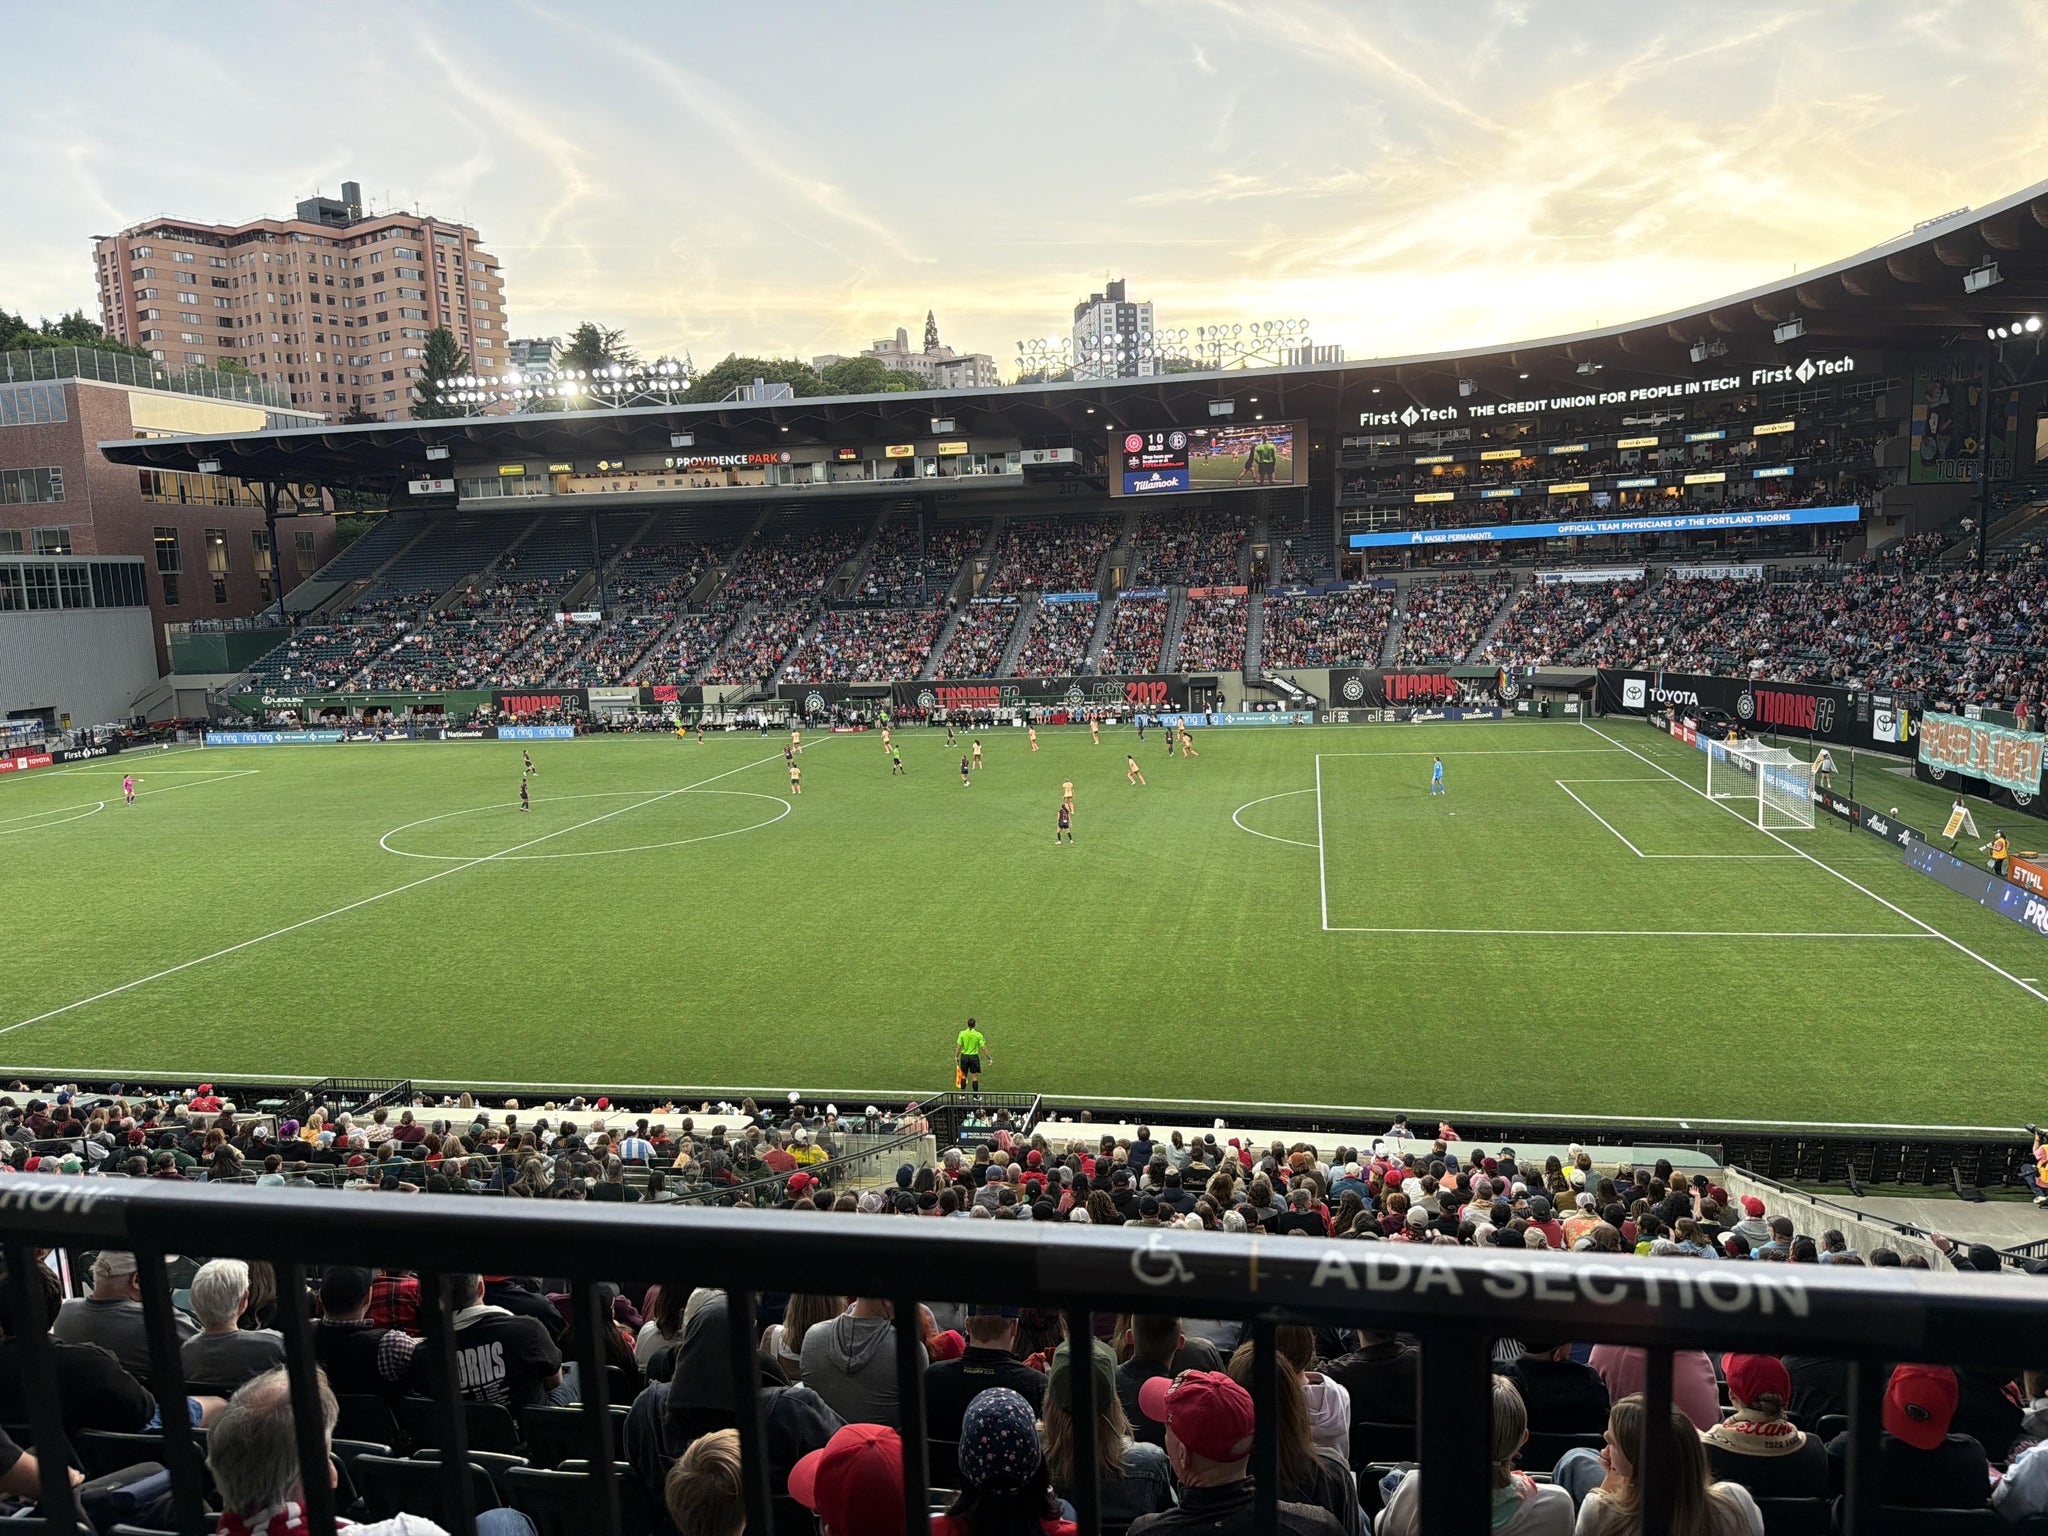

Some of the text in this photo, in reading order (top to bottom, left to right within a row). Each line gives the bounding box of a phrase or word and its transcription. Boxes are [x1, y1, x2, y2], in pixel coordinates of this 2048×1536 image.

[1752, 356, 1854, 385] First Tech
[1469, 376, 1740, 417] THE CREDIT UNION FOR PEOPLE IN TECH
[1360, 406, 1458, 426] First Tech
[1148, 433, 1163, 444] 1 0
[1690, 432, 1720, 441] THINKERS
[1553, 445, 1584, 453] CREATORS
[677, 453, 778, 468] PROVIDENCE PARK
[1759, 468, 1788, 477] BUILDERS
[1059, 483, 1080, 495] 217
[1134, 477, 1179, 491] Tillamook
[1619, 479, 1655, 487] DISRUPTORS
[1487, 489, 1514, 497] LEADERS
[1558, 513, 1791, 533] OFFICIAL TEAM PHYSICIANS OF THE PORTLAND THORNS
[1424, 535, 1447, 543] KAISER
[1127, 681, 1167, 705] 2012
[1383, 674, 1457, 700] THORNS
[935, 686, 1000, 709] THORNS
[1649, 688, 1699, 705] TOYOTA
[501, 695, 560, 717] THORNS
[1755, 690, 1835, 733] THORNS FC
[1160, 715, 1177, 725] ring
[1321, 711, 1336, 723] elf
[1367, 710, 1383, 722] elf
[1417, 711, 1446, 720] illamook
[1461, 711, 1494, 720] Tillamook
[500, 728, 515, 738] ring
[518, 728, 533, 738] ring
[539, 727, 555, 737] ring
[557, 727, 573, 737] ring
[207, 734, 221, 743] ring
[223, 734, 237, 743] ring
[243, 734, 257, 743] ring
[259, 734, 273, 743] ring
[64, 747, 107, 759] First Tech
[28, 757, 51, 765] TOYOTA
[1867, 814, 1888, 836] Alaska
[2013, 866, 2044, 891] STIHL
[1310, 1248, 1811, 1317] ADA SECTION
[456, 1341, 506, 1389] ORNS
